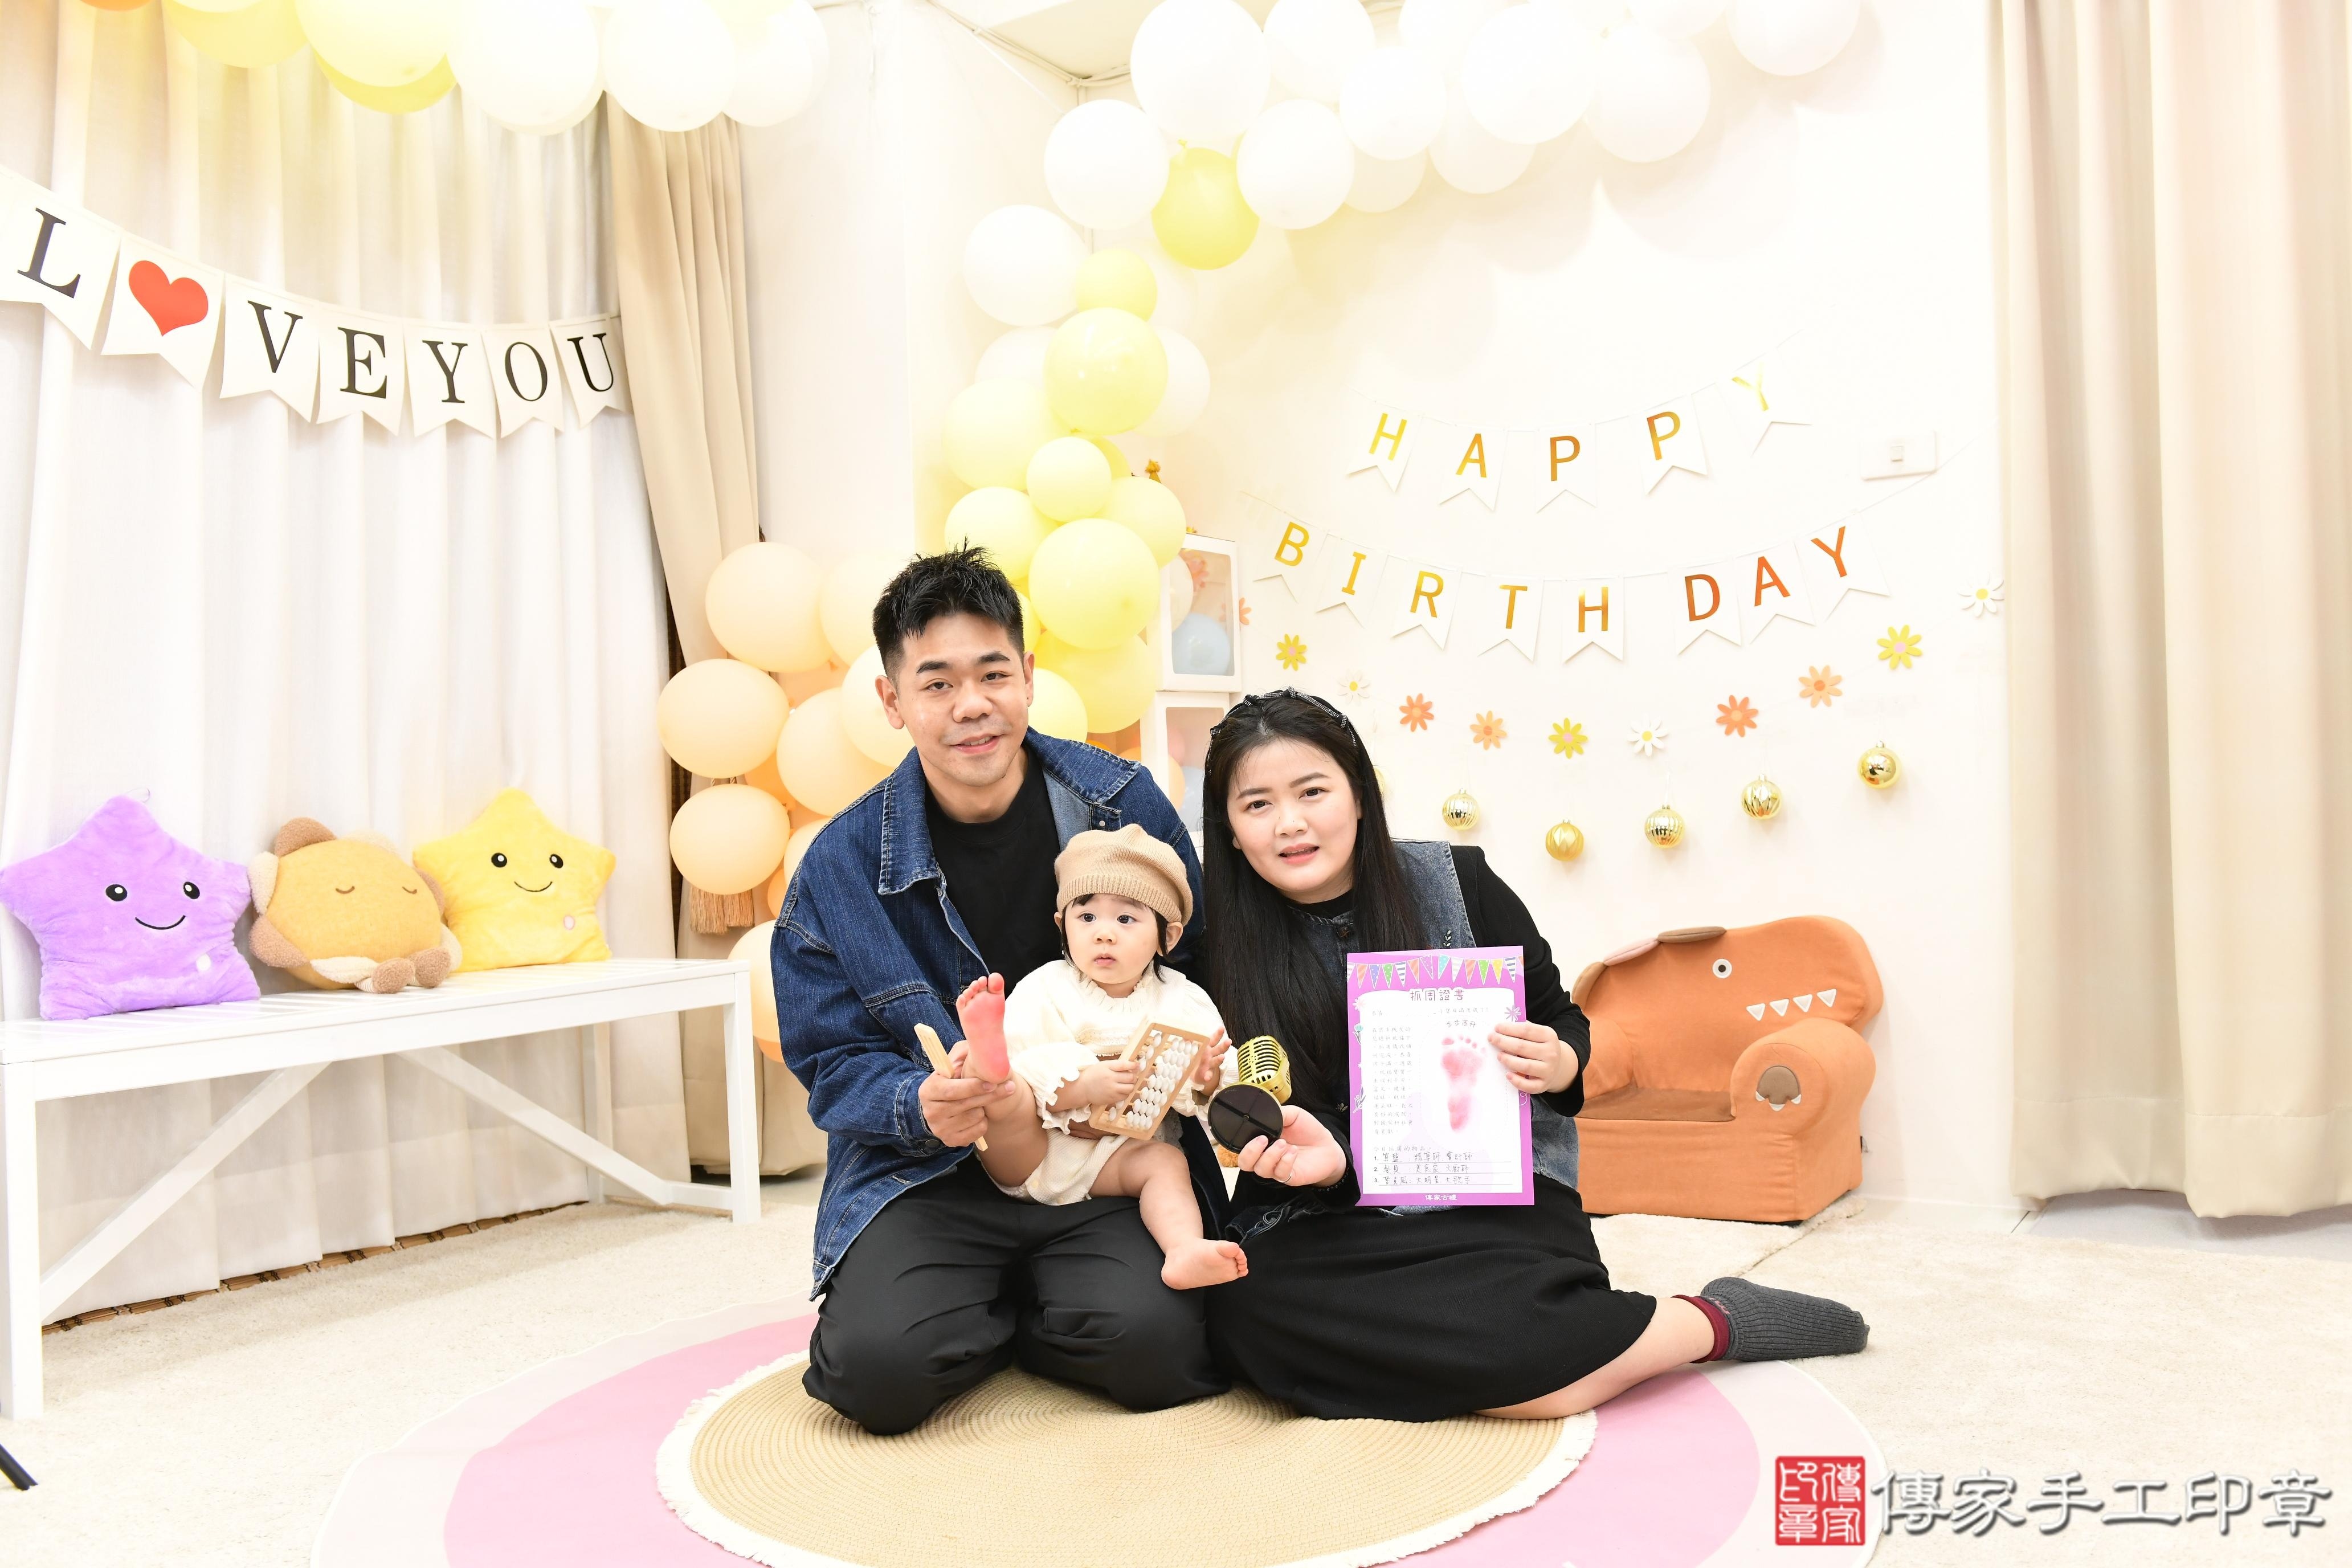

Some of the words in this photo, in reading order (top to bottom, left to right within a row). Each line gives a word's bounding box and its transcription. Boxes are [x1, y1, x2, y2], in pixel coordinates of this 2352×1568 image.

[1369, 361, 1773, 482] HAPPY
[1274, 525, 1849, 634] BIRTHDAY
[1410, 989, 1465, 1002] 抓周證書
